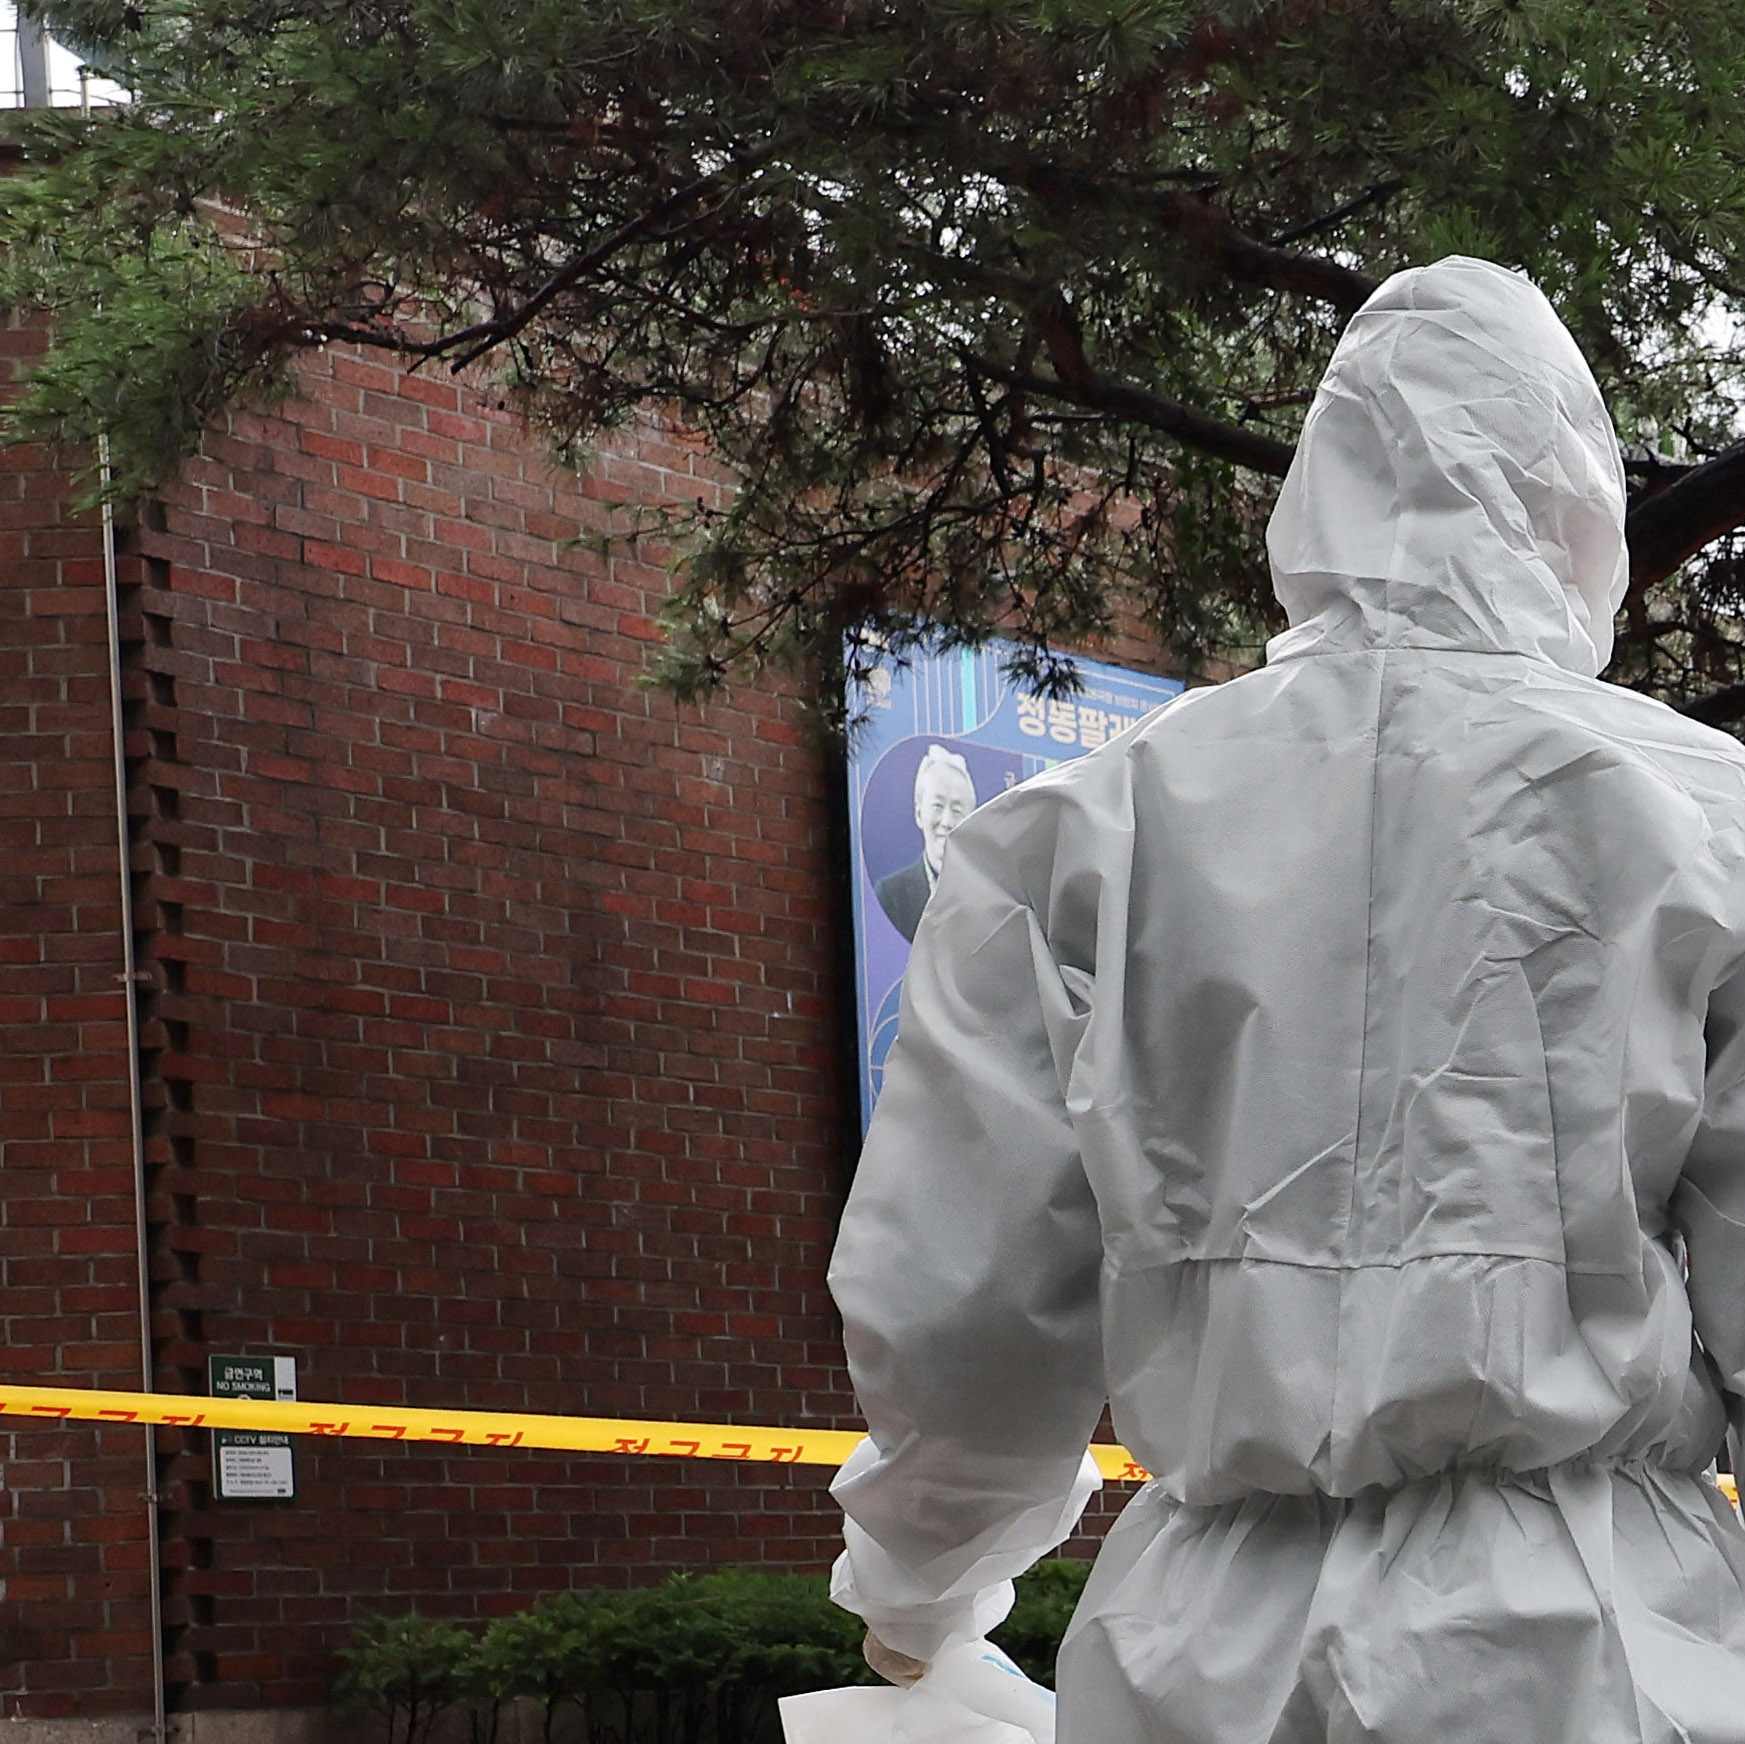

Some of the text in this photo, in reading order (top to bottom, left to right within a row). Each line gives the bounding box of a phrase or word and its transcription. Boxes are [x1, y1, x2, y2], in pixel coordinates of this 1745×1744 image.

[217, 1381, 271, 1393] NO SMOKING
[234, 1435, 256, 1445] CCTV
